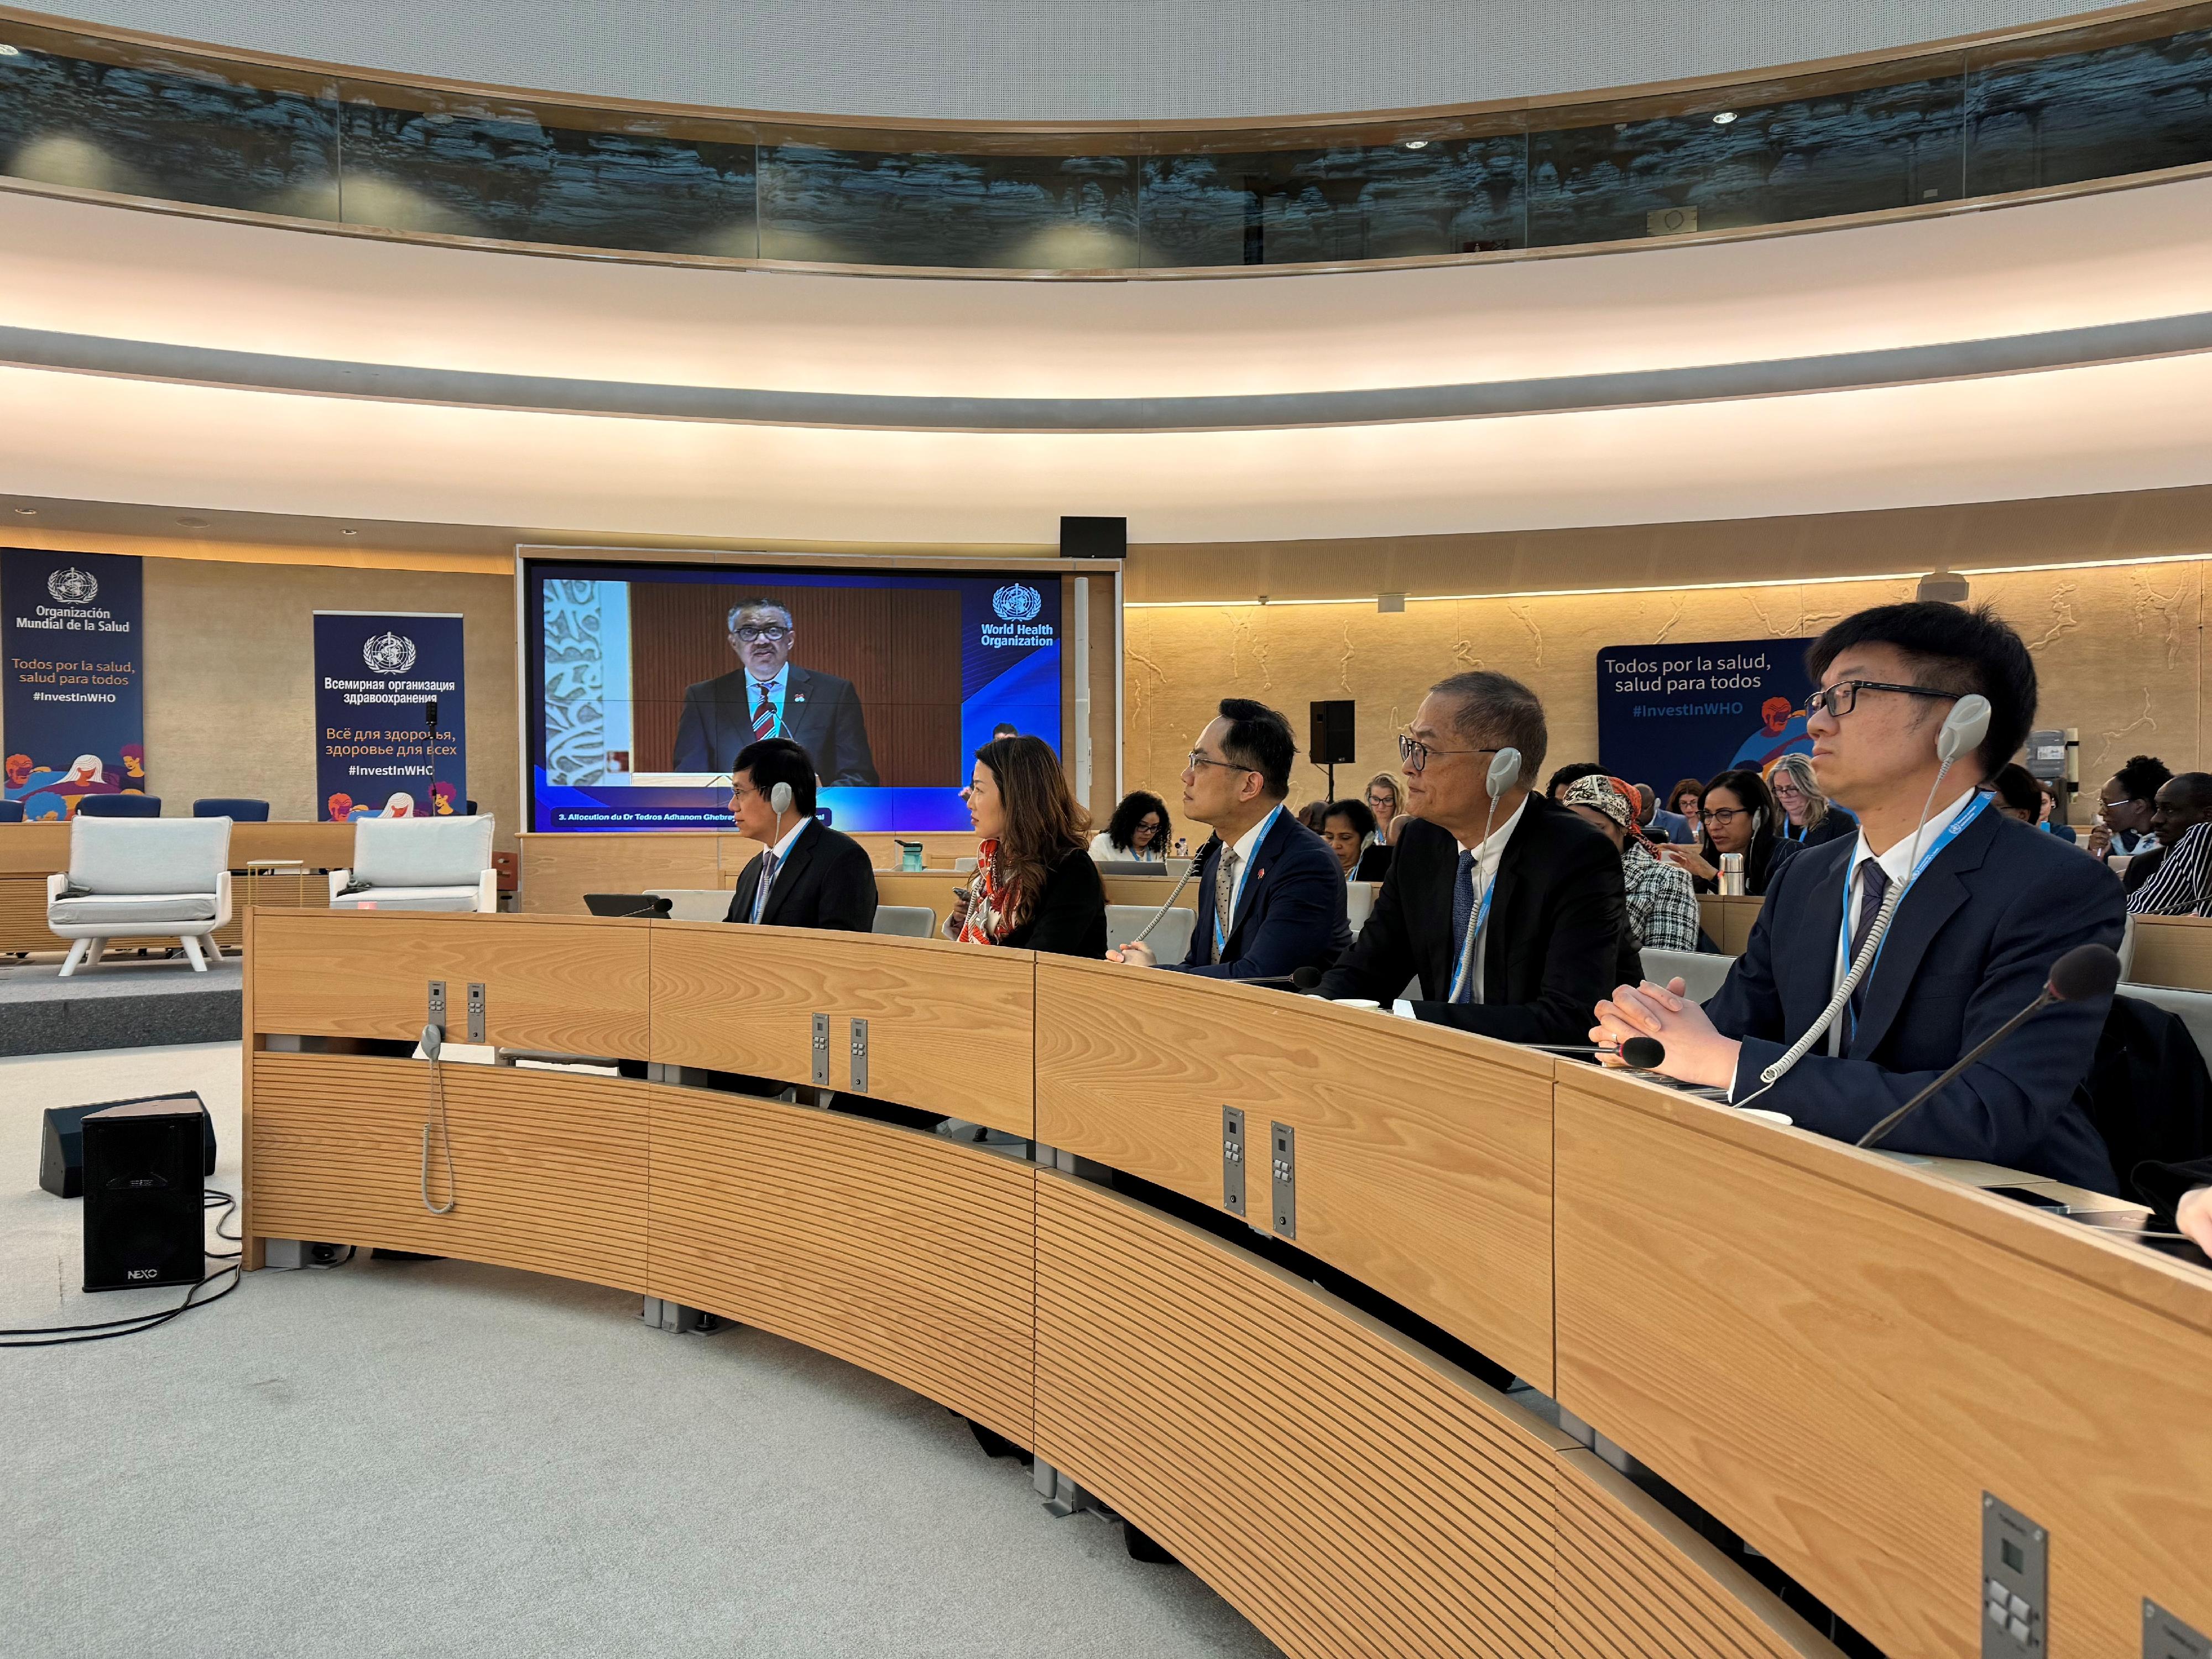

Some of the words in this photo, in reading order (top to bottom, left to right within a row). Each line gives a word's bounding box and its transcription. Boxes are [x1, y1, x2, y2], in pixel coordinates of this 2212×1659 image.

[36, 605, 111, 619] Organización
[16, 618, 63, 630] Mundial
[66, 619, 81, 630] de
[84, 620, 95, 631] la
[98, 620, 129, 632] Salud
[981, 624, 1014, 634] World
[1017, 624, 1053, 635] Health
[981, 635, 1053, 649] Organization
[12, 658, 52, 670] Todos
[56, 661, 78, 672] por
[81, 661, 93, 671] la
[96, 662, 135, 674] salud,
[1605, 659, 1657, 674] Todos
[1663, 659, 1693, 675] por
[1697, 656, 1712, 671] la
[1717, 653, 1771, 671] salud,
[19, 672, 55, 684] salud
[60, 675, 88, 686] para
[92, 674, 129, 685] todos
[325, 677, 384, 692] Всемирная
[388, 680, 455, 692] организация
[1615, 677, 1661, 692] salud
[1667, 677, 1705, 695] para
[1710, 674, 1761, 689] todos
[33, 692, 116, 703] #InvestInWHO
[343, 692, 437, 705] здравоохранения
[1633, 702, 1743, 717] #InvestInWHO
[326, 728, 351, 740] Всё
[354, 730, 380, 742] для
[384, 731, 456, 743] здороья,
[325, 745, 393, 758] здоровье
[397, 745, 422, 757] для
[426, 746, 457, 755] всех
[128, 1269, 158, 1280] NEXO
